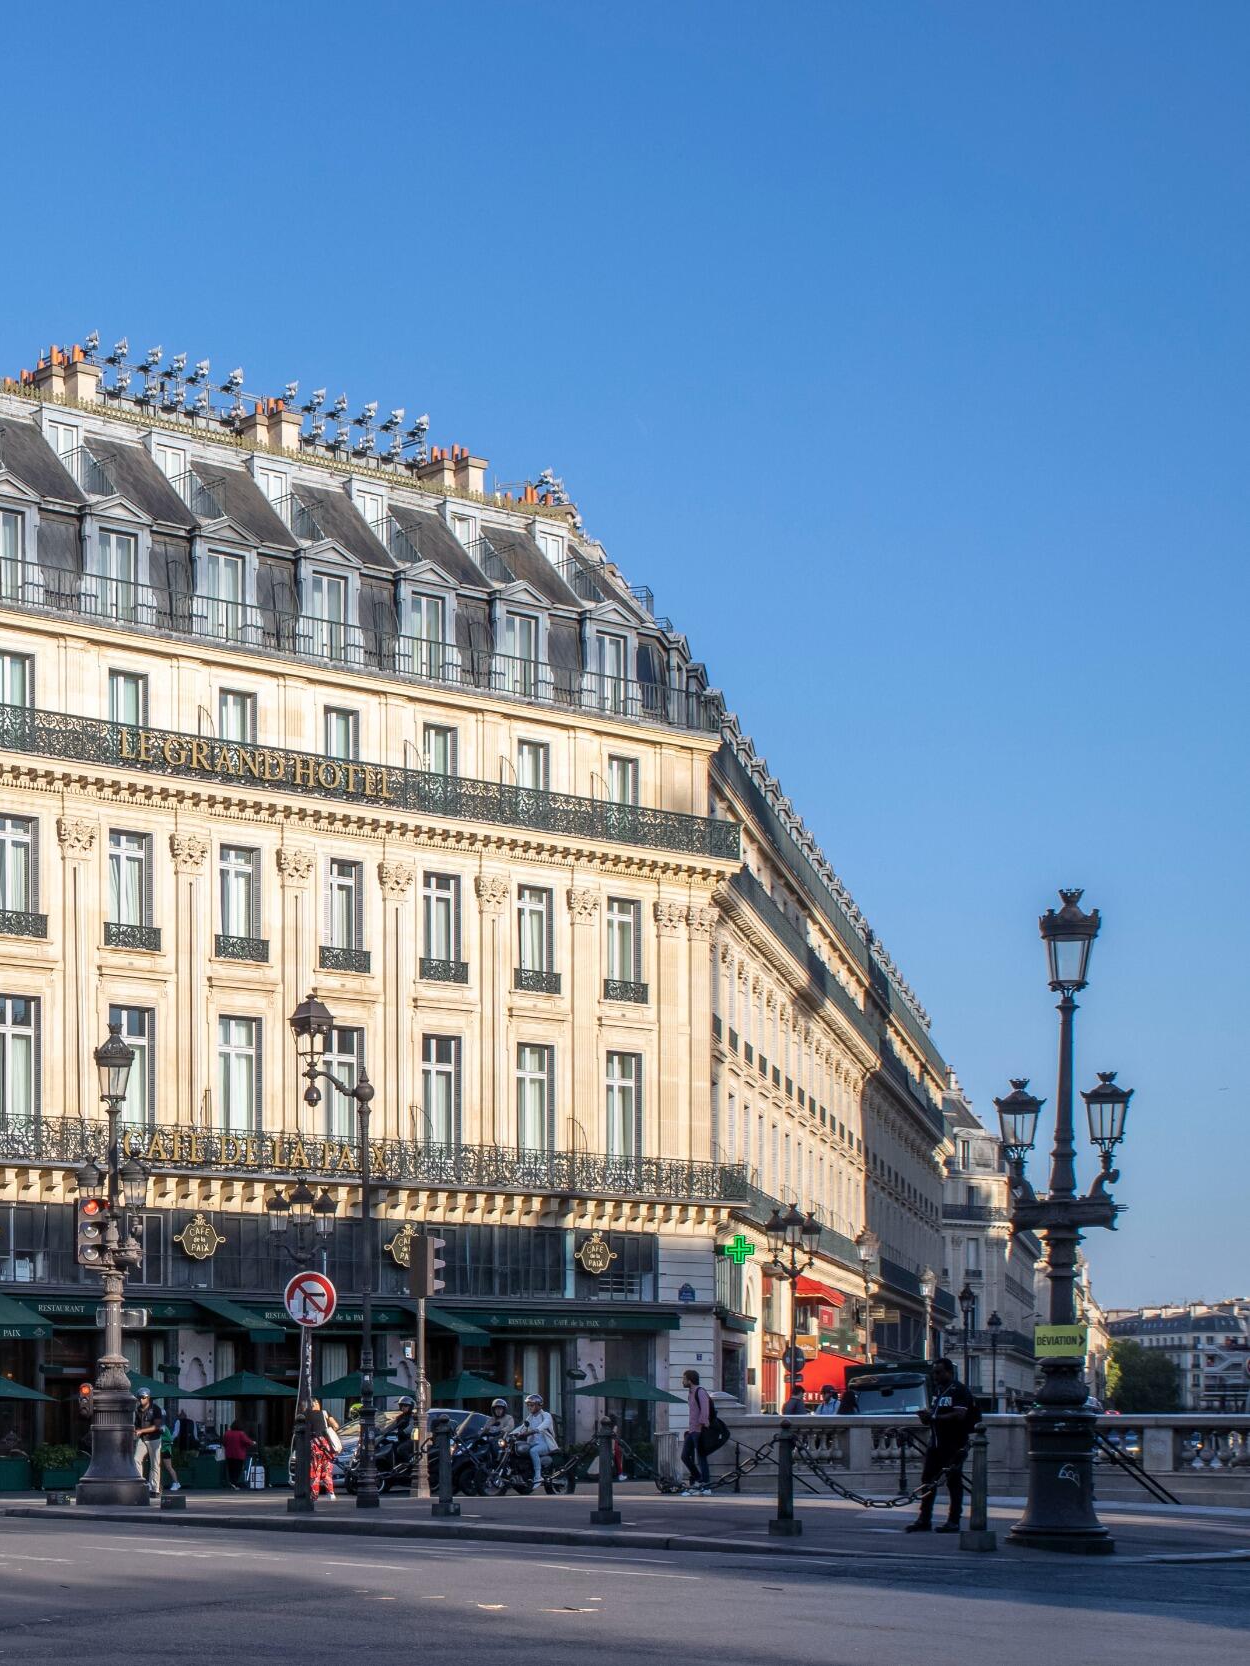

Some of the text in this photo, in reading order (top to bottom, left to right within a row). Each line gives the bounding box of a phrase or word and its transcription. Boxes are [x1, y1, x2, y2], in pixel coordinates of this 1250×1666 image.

[119, 729, 394, 798] LE GRAND HOTEL
[218, 1136, 259, 1165] DE
[271, 1139, 310, 1168] LA
[323, 1142, 387, 1173] PAX
[191, 1243, 209, 1252] PAIX
[38, 1304, 86, 1313] RESTAURANT
[3, 1329, 21, 1337] PAIX
[1036, 1334, 1078, 1346] DÉVIATION
